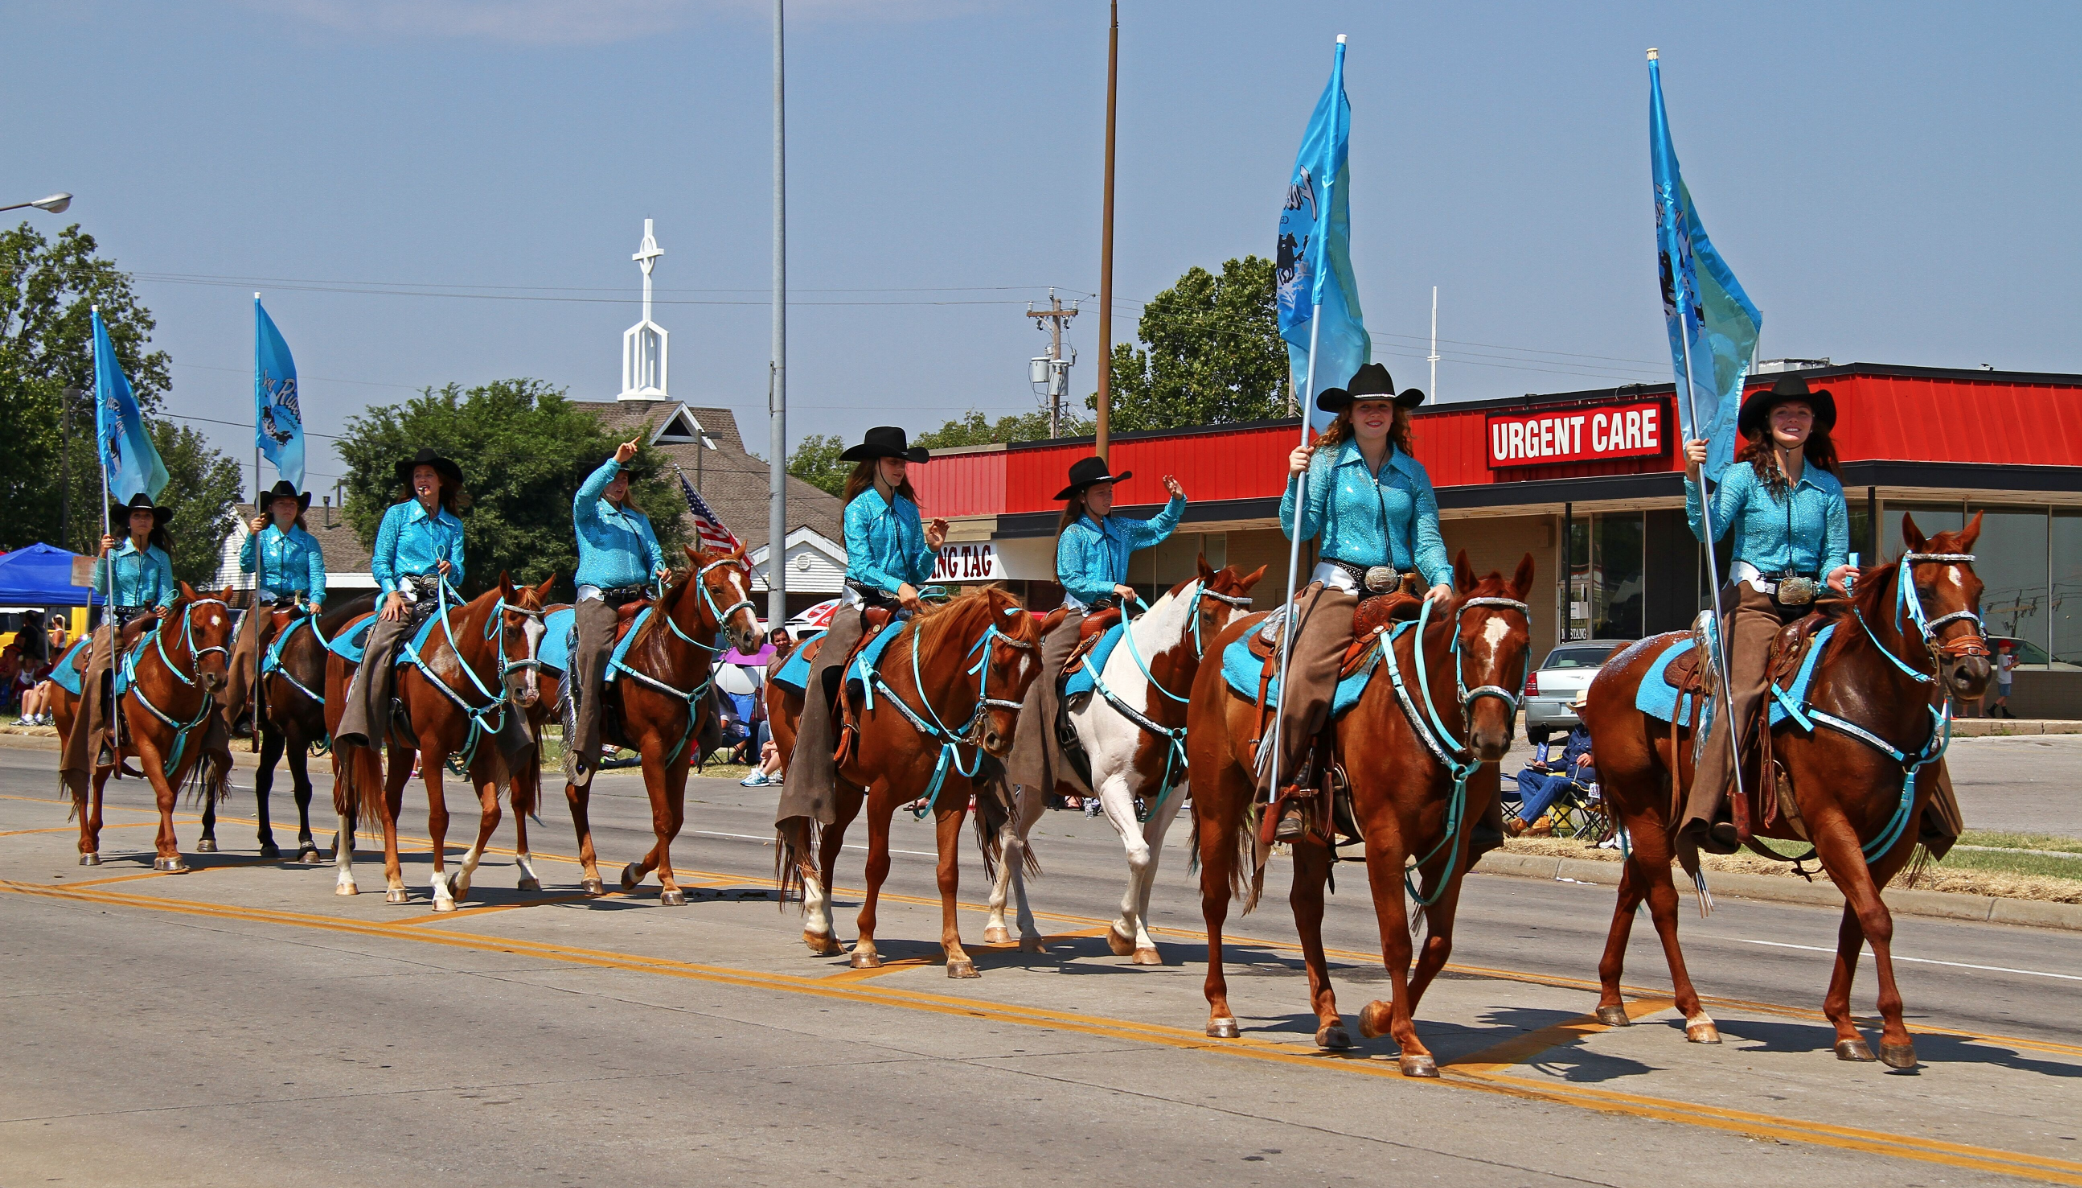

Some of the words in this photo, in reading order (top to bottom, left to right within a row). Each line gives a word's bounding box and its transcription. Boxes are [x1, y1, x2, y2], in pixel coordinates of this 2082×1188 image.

[273, 408, 299, 430] OKLAHOMA
[1492, 416, 1585, 461] URGENT
[1592, 408, 1658, 453] CARE
[932, 546, 958, 579] NG
[961, 544, 992, 578] TAG
[1561, 628, 1587, 640] STANG
